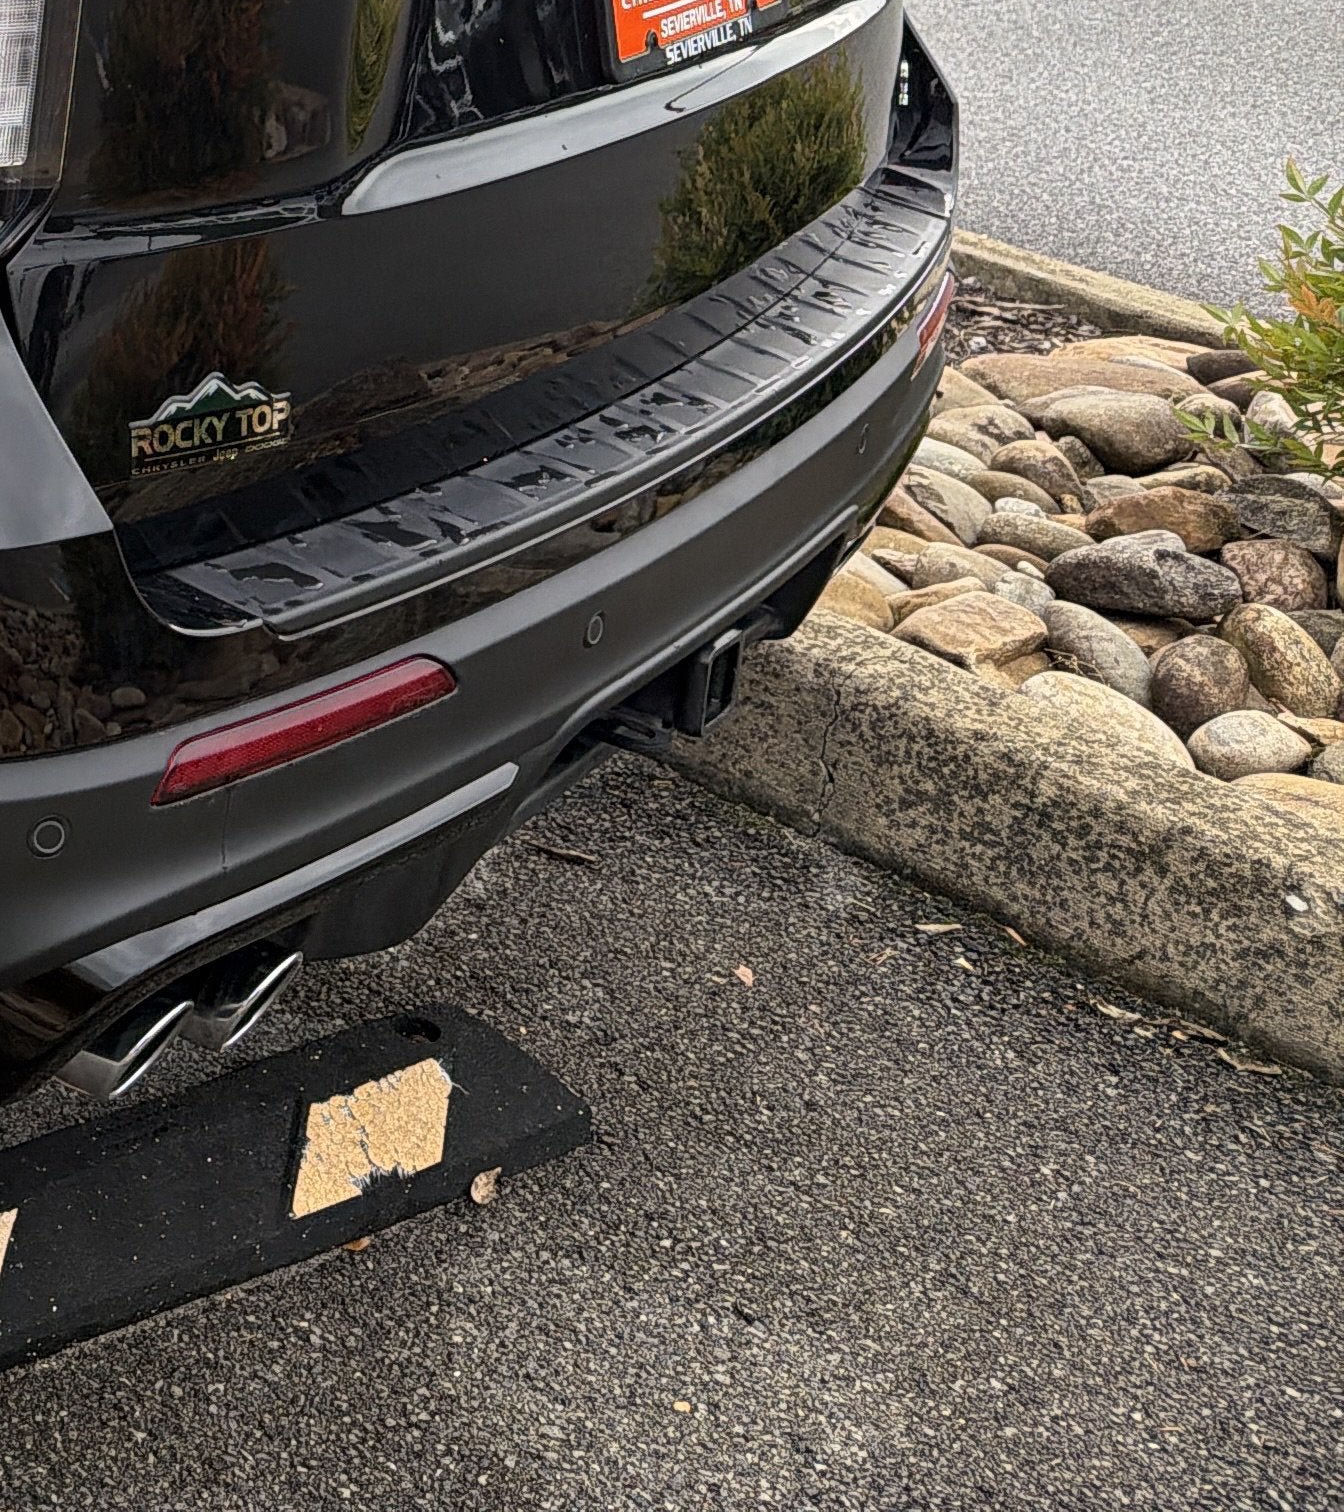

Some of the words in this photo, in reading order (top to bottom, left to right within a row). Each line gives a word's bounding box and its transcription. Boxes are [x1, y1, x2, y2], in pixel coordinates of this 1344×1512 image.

[665, 22, 737, 66] SEVIERVILLE,
[737, 15, 753, 37] TN
[130, 412, 231, 458] ROCKY
[235, 400, 291, 437] TOP
[131, 455, 207, 476] CHRYSLER
[213, 447, 239, 462] Jeep
[244, 438, 289, 454] DODGE
